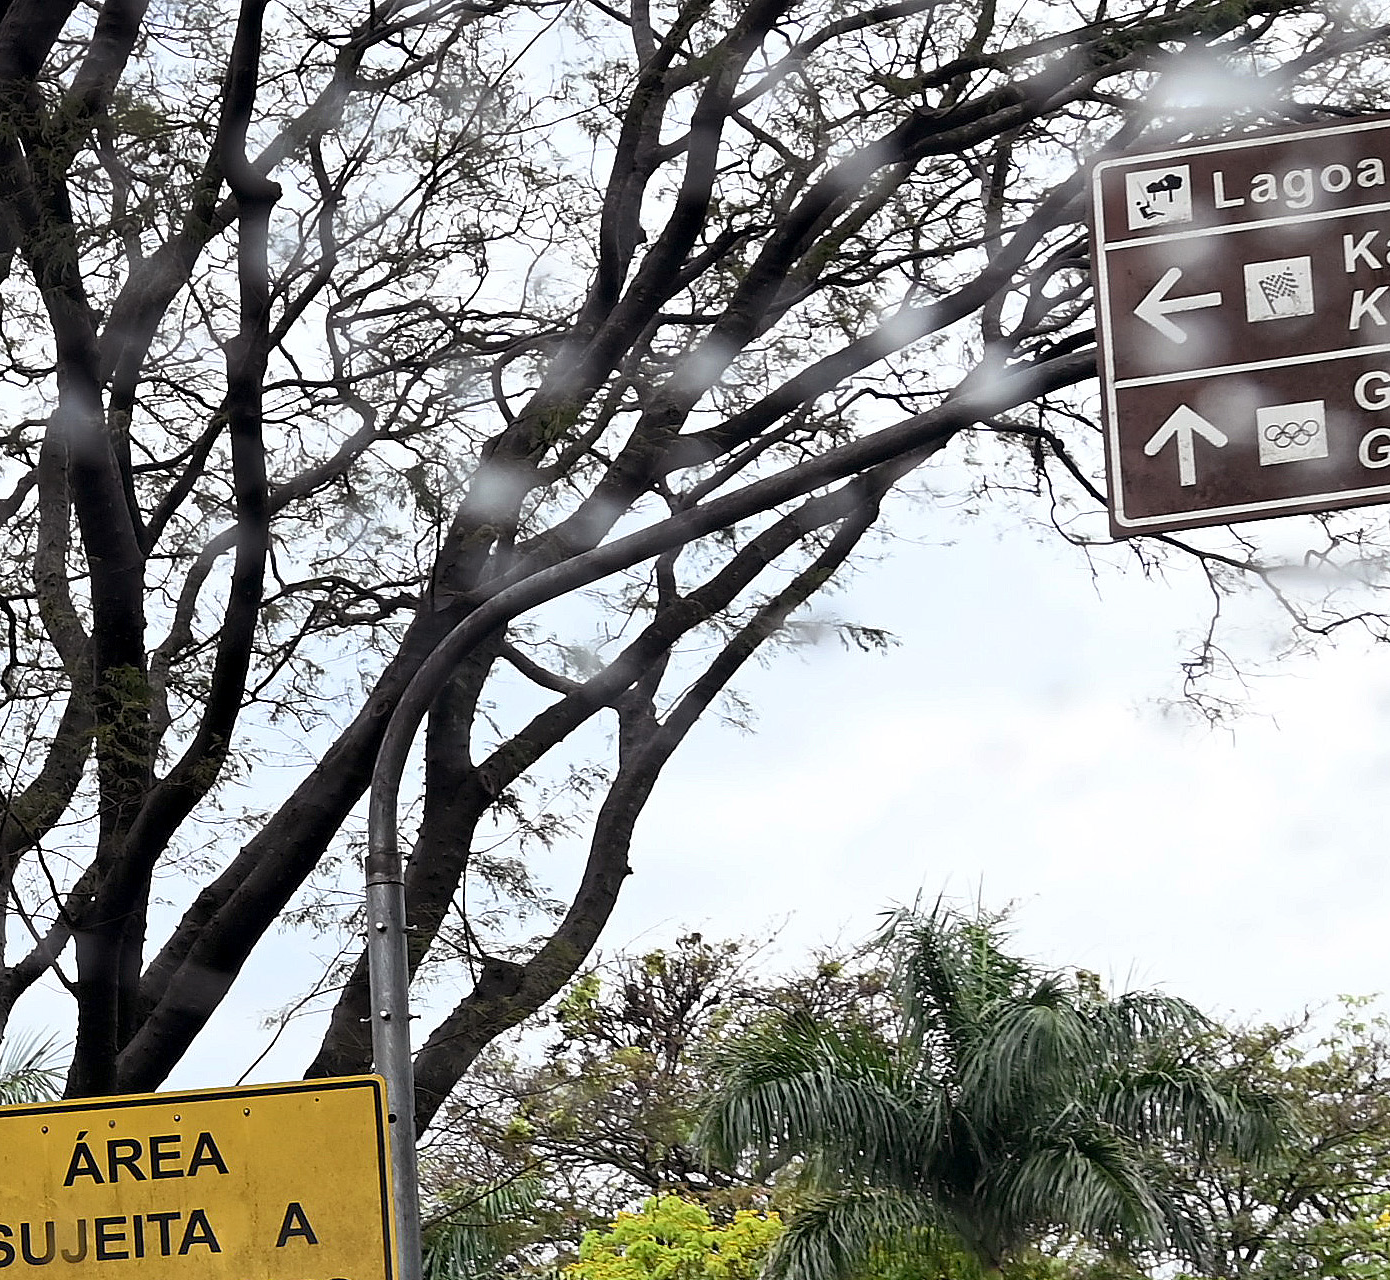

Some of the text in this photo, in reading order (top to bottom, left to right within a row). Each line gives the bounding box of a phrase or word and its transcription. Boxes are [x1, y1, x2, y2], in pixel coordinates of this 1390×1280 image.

[1212, 155, 1385, 209] Lagoa
[63, 1130, 229, 1187] ÁREA
[275, 1202, 319, 1248] A
